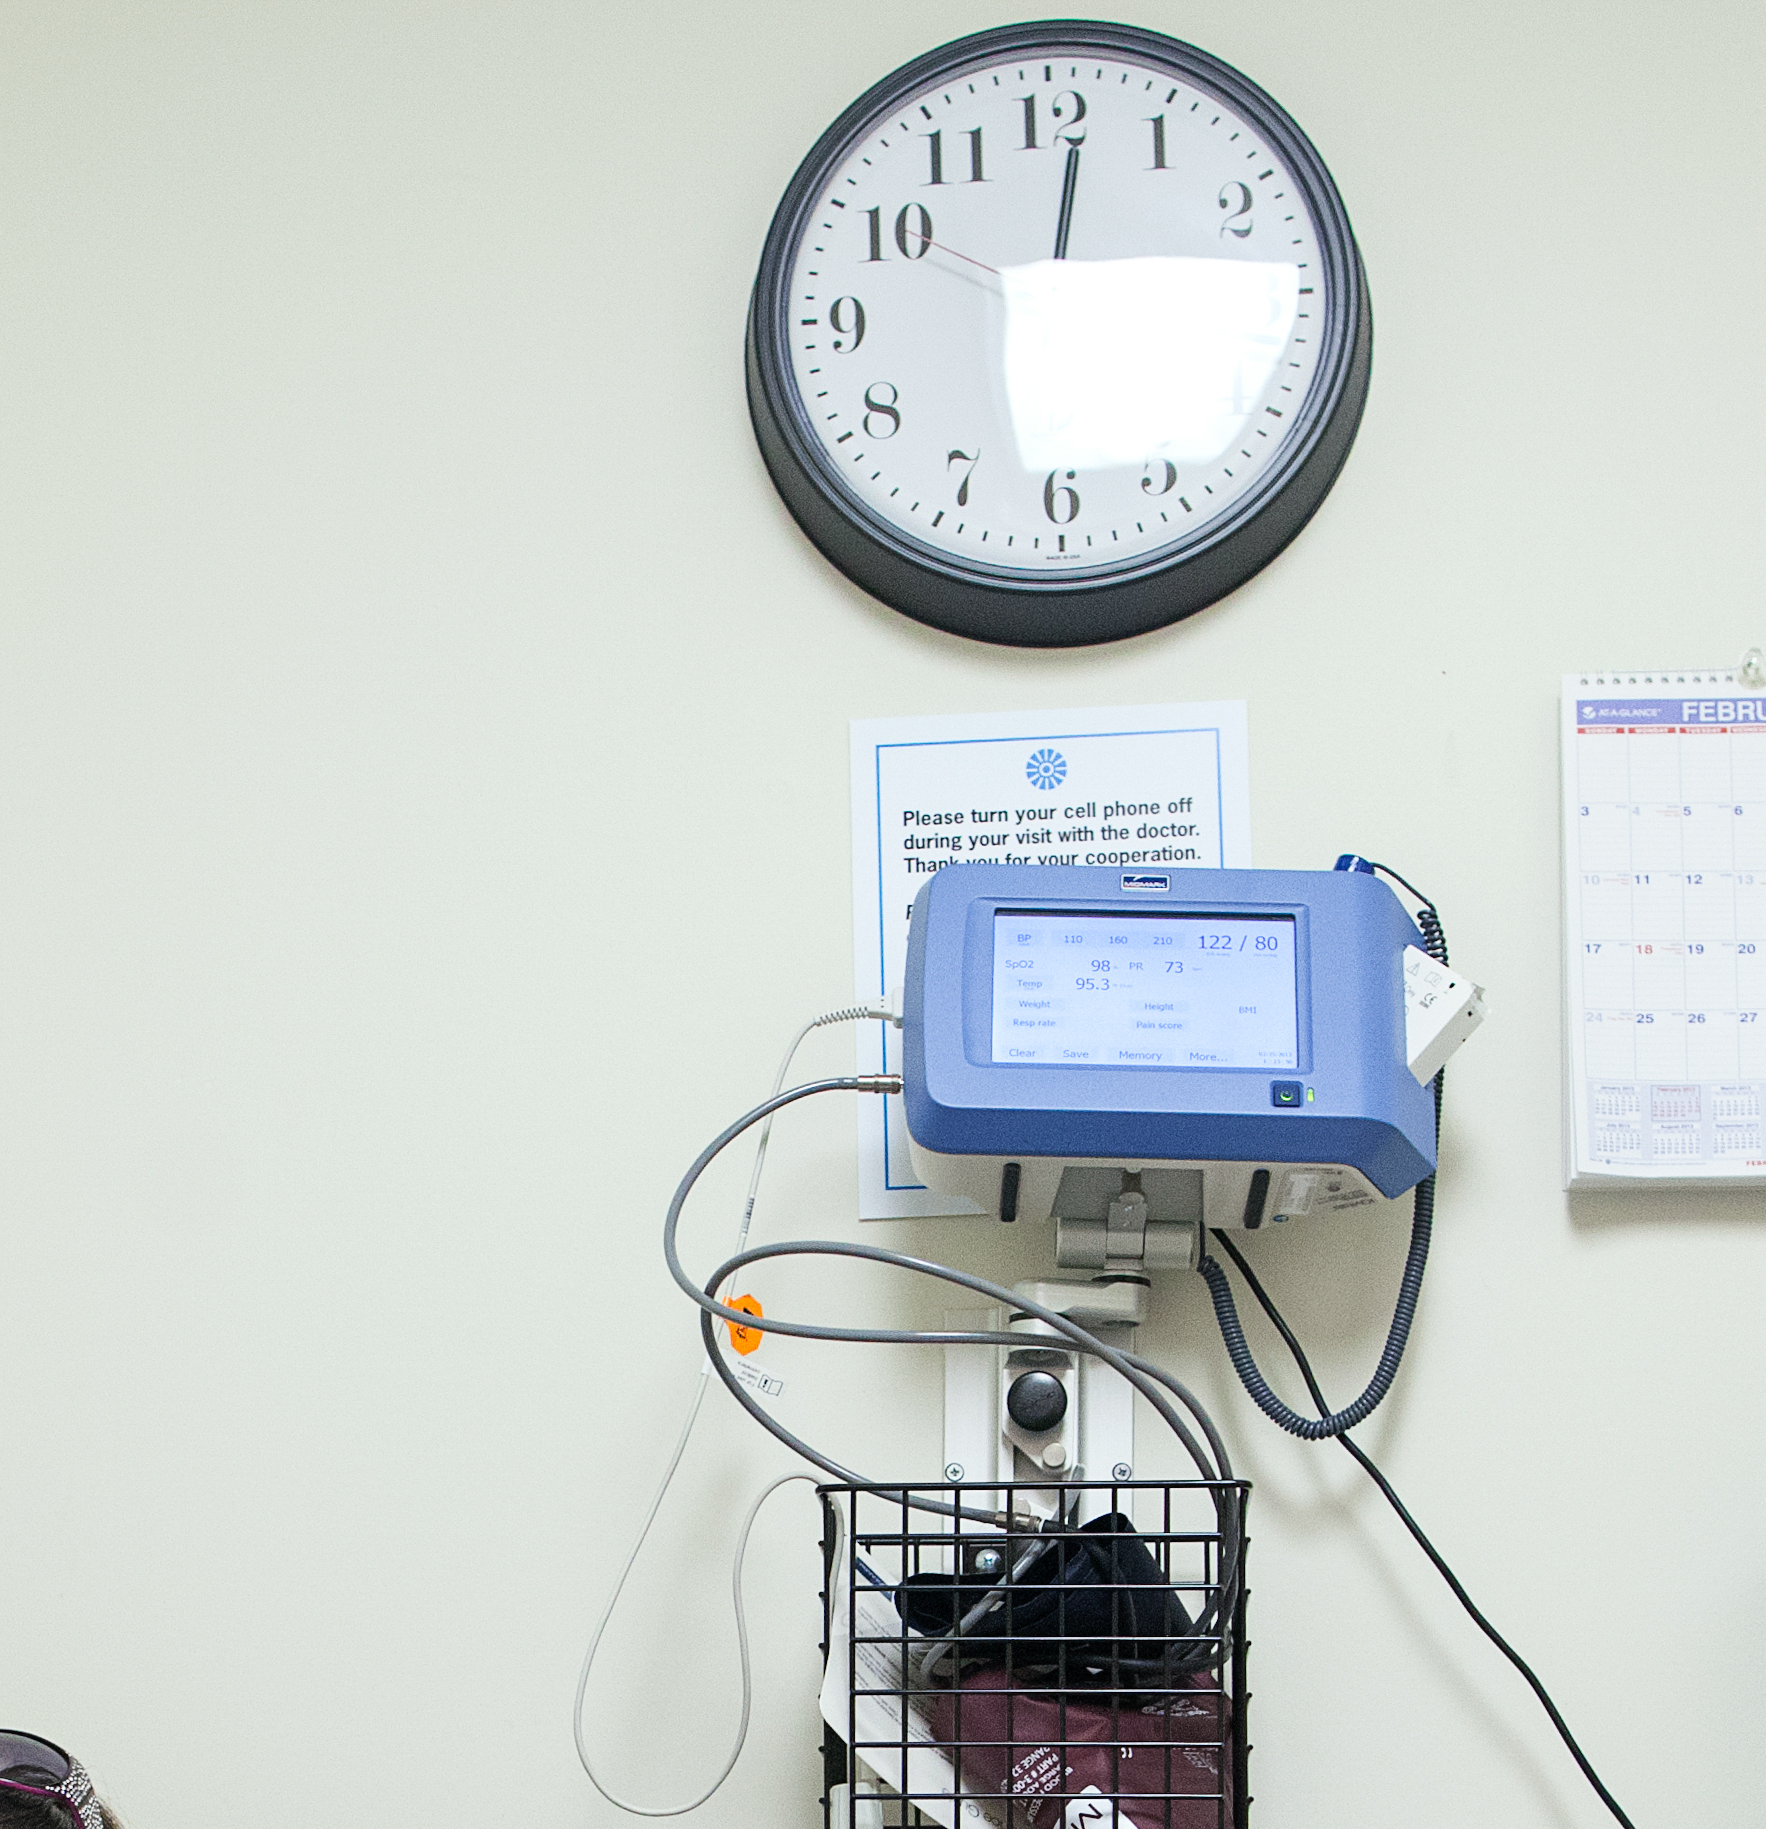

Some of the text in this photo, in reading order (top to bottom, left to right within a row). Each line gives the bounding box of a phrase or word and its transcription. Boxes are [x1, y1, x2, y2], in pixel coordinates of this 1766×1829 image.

[1015, 90, 1088, 150] 12
[1143, 114, 1176, 170] 1
[920, 127, 992, 186] 11
[1218, 182, 1254, 239] 2
[859, 202, 933, 262] 10
[829, 295, 866, 354] 9
[862, 382, 901, 439] 8
[947, 447, 980, 506] 7
[1141, 446, 1178, 496] 5
[1044, 466, 1080, 525] 6
[903, 797, 1193, 826] Please turn your cell phone off
[1580, 806, 1590, 816] 3
[1683, 805, 1692, 816] 5
[1734, 805, 1743, 816] 6
[904, 822, 1200, 850] during your visit with the doctor.
[1005, 853, 1030, 865] for
[1085, 846, 1201, 866] cooperation.
[1634, 874, 1650, 885] 11
[1686, 874, 1703, 885] 12
[1017, 934, 1278, 952] BP 110 160 210 122 / 80
[1585, 943, 1602, 954] 17
[1636, 944, 1653, 955] 18
[1687, 943, 1705, 955] 19
[1738, 943, 1756, 955] 20
[1005, 960, 1034, 969] SpO2
[1091, 960, 1110, 972] 98
[1129, 962, 1144, 970] PR
[1165, 961, 1183, 973] 73
[1017, 979, 1043, 988] Temp
[1075, 977, 1110, 990] 95.3
[1019, 1000, 1257, 1014] Weight Height BMI
[1636, 1013, 1654, 1024] 25
[1688, 1013, 1706, 1024] 26
[1739, 1012, 1758, 1023] 27
[1013, 1019, 1035, 1028] Resp
[1038, 1019, 1056, 1027] rate
[1136, 1021, 1155, 1029] Pain
[1009, 1049, 1228, 1062] Clear Save Memory More...
[1037, 1753, 1059, 1774] PART
